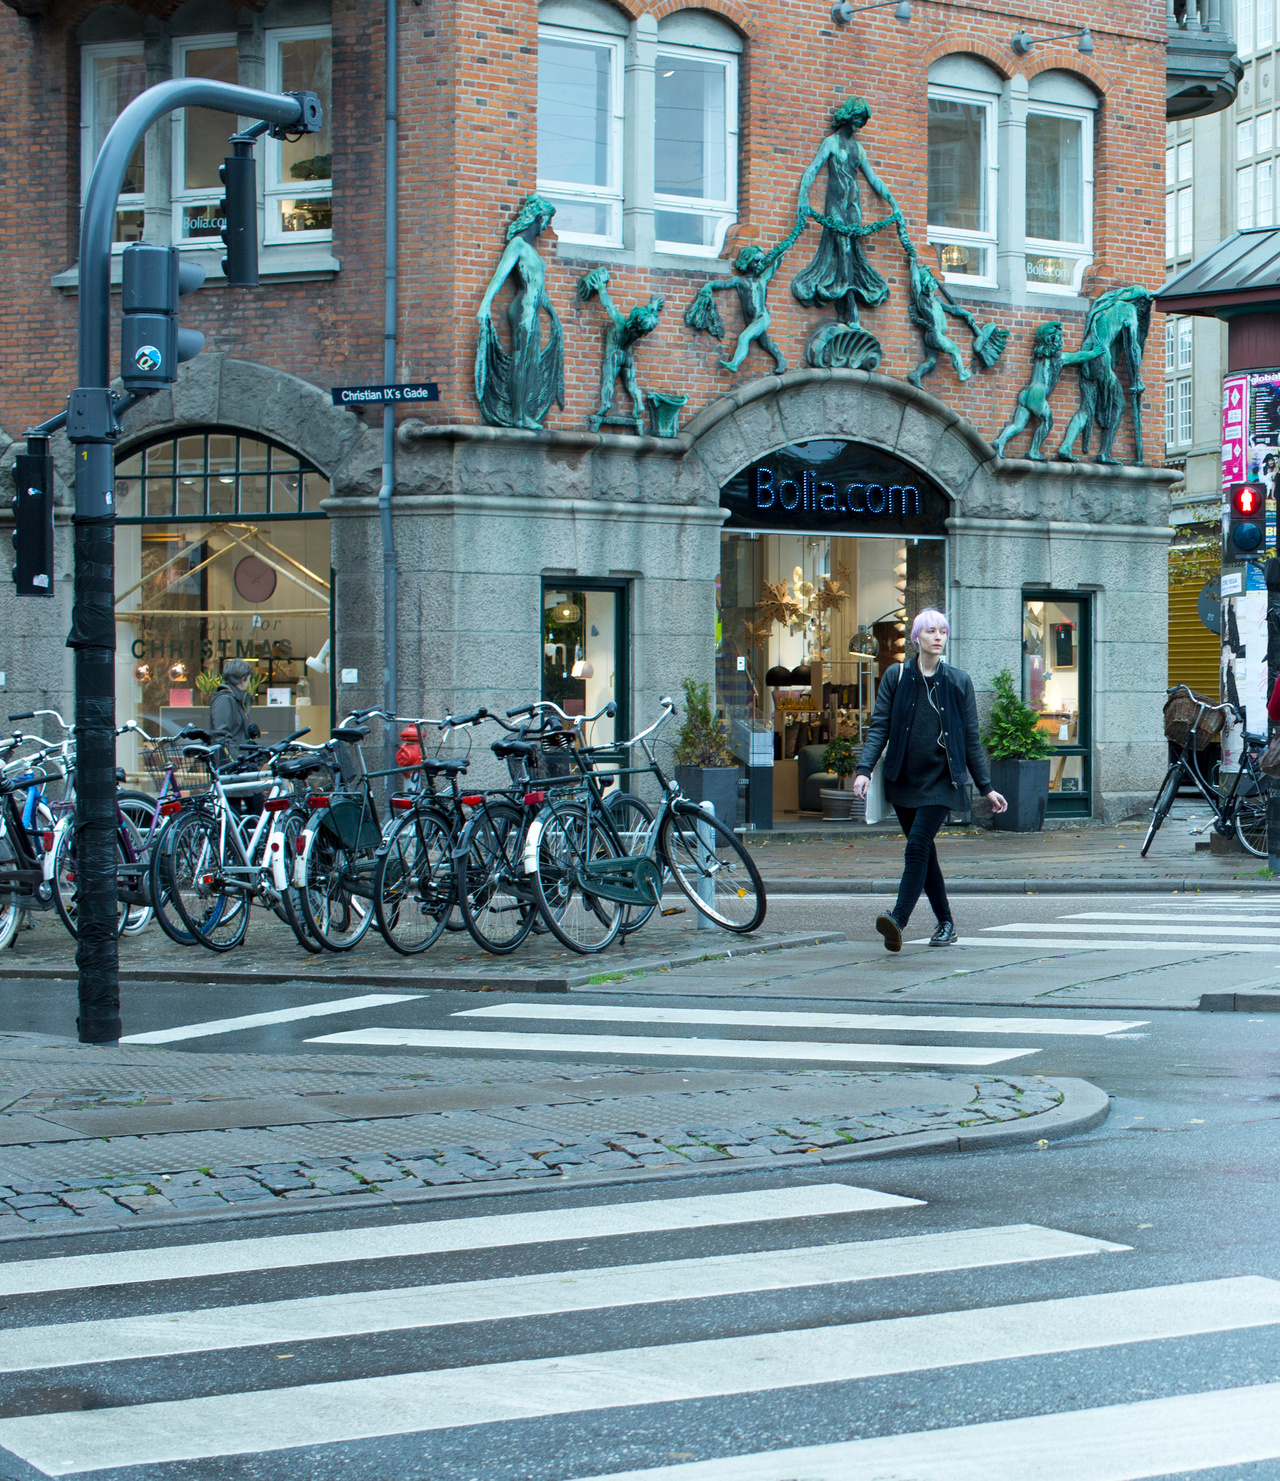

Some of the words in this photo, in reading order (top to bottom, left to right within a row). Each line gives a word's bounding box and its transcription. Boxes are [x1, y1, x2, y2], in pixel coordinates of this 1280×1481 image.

[341, 390, 382, 401] Christian
[403, 387, 429, 398] Gade
[756, 467, 920, 515] Bolia.com
[196, 618, 244, 632] room
[250, 613, 282, 636] for
[131, 637, 293, 660] CHRISTMAS
